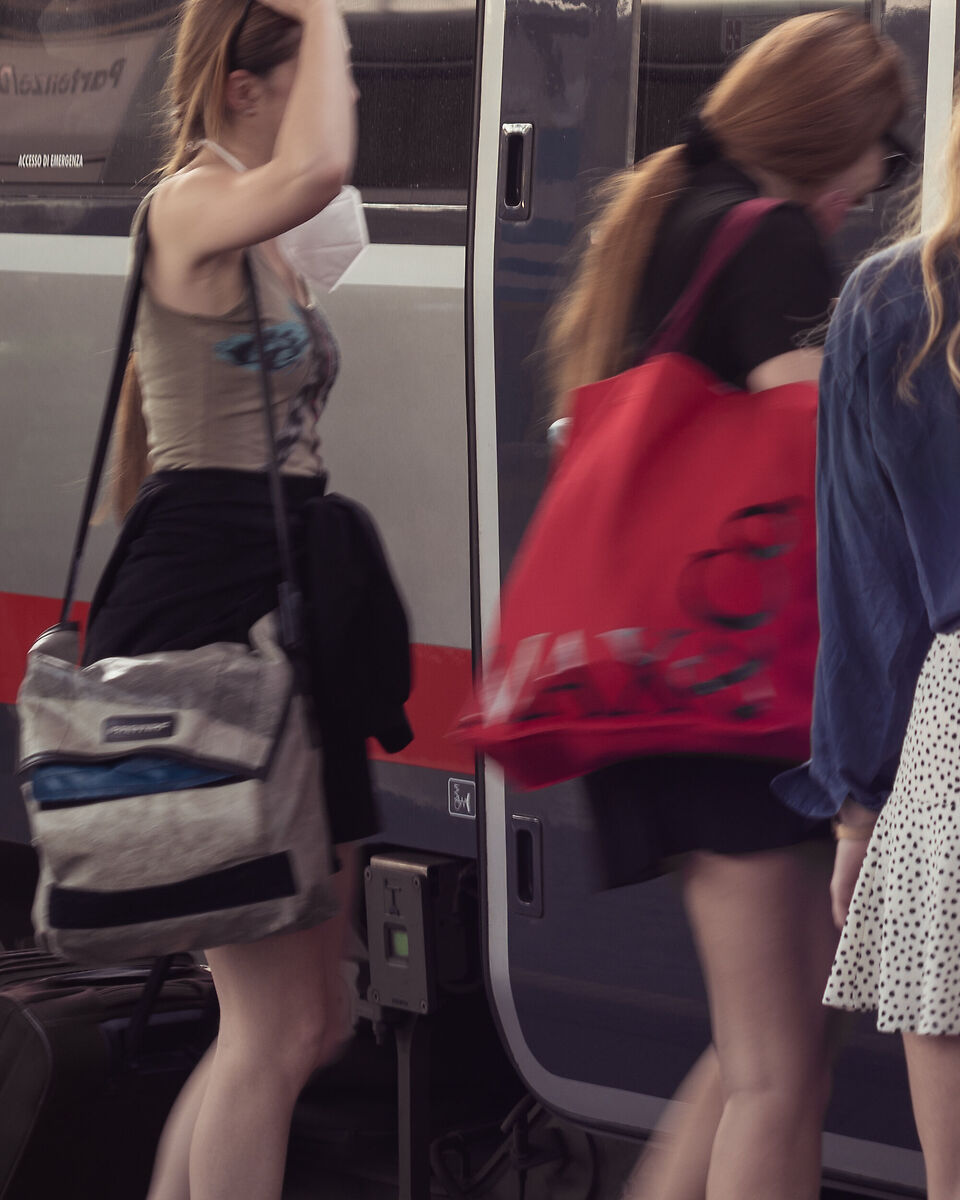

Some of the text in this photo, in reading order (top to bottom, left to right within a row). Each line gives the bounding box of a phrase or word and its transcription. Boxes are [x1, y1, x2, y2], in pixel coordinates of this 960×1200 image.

[18, 154, 83, 168] ACCESSO DI EMERGENZA
